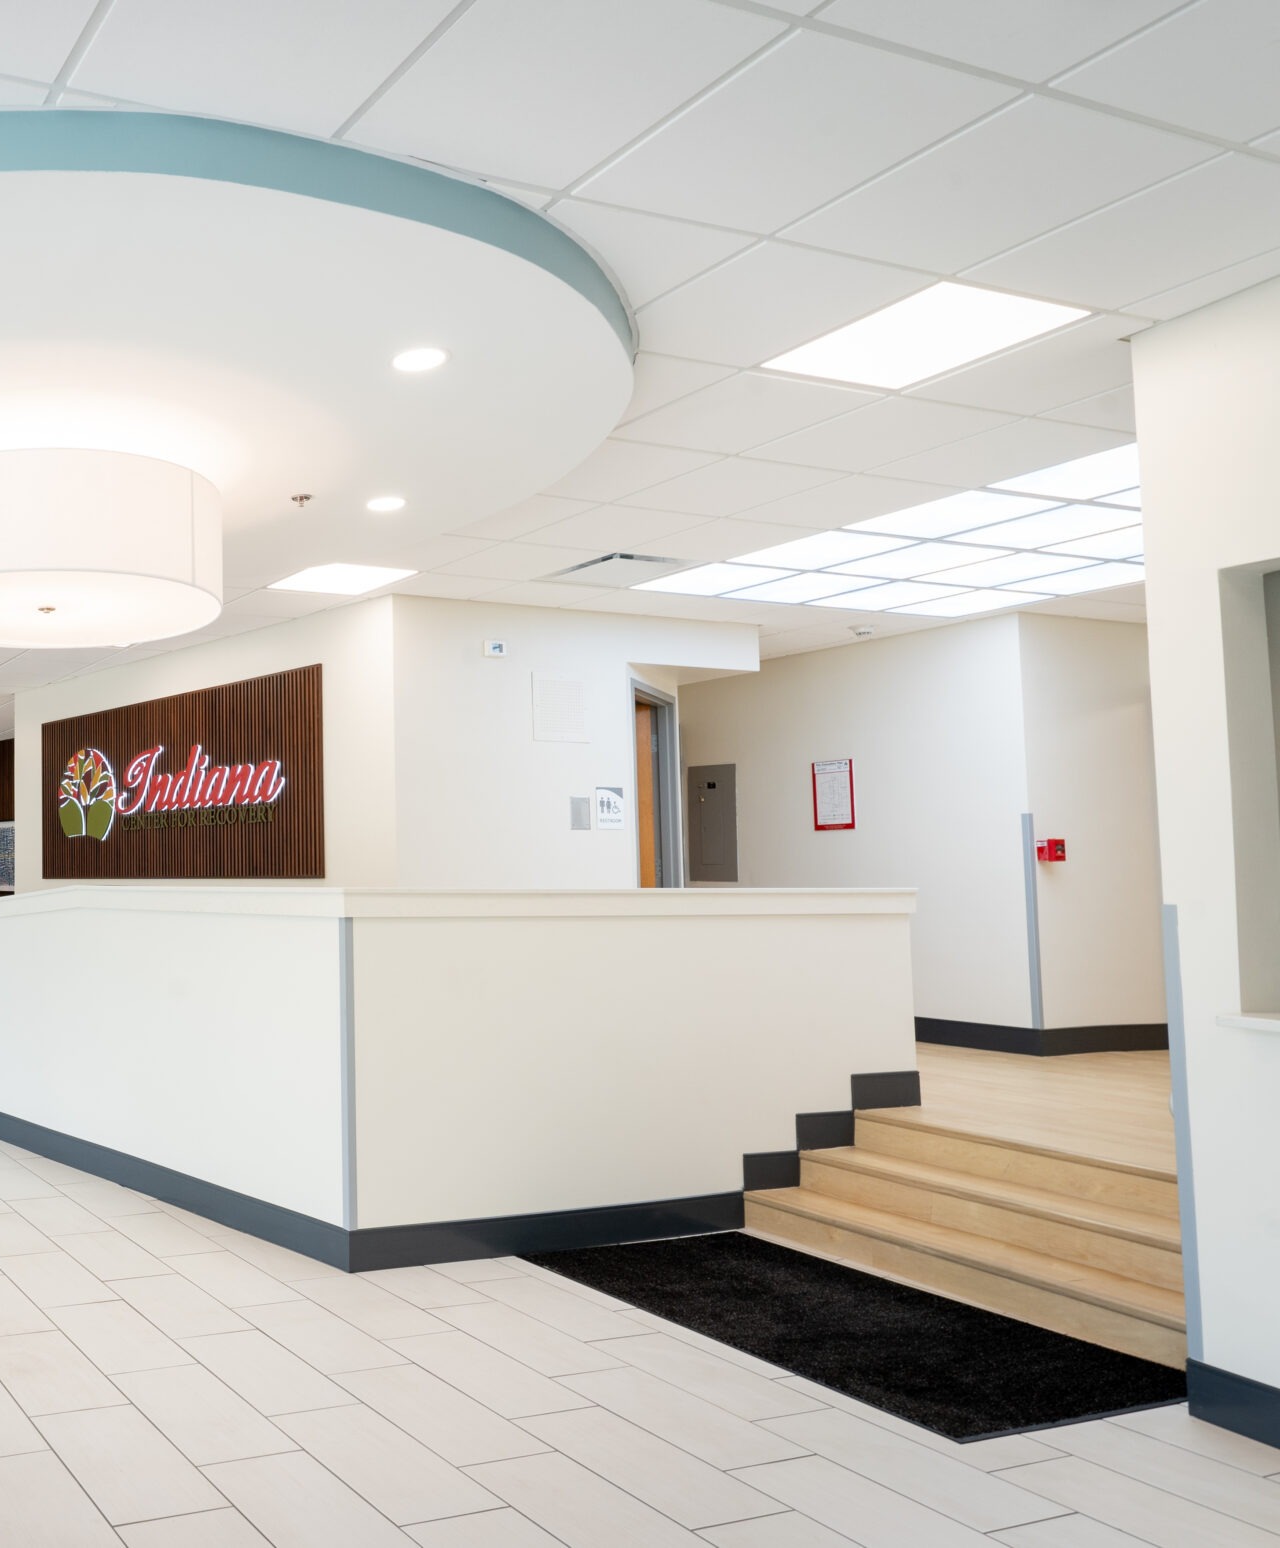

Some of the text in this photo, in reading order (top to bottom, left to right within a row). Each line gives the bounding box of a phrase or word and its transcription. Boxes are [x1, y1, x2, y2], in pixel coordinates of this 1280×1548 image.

[115, 744, 286, 815] Indiana
[122, 803, 278, 831] CENTER FOR RECOVERY
